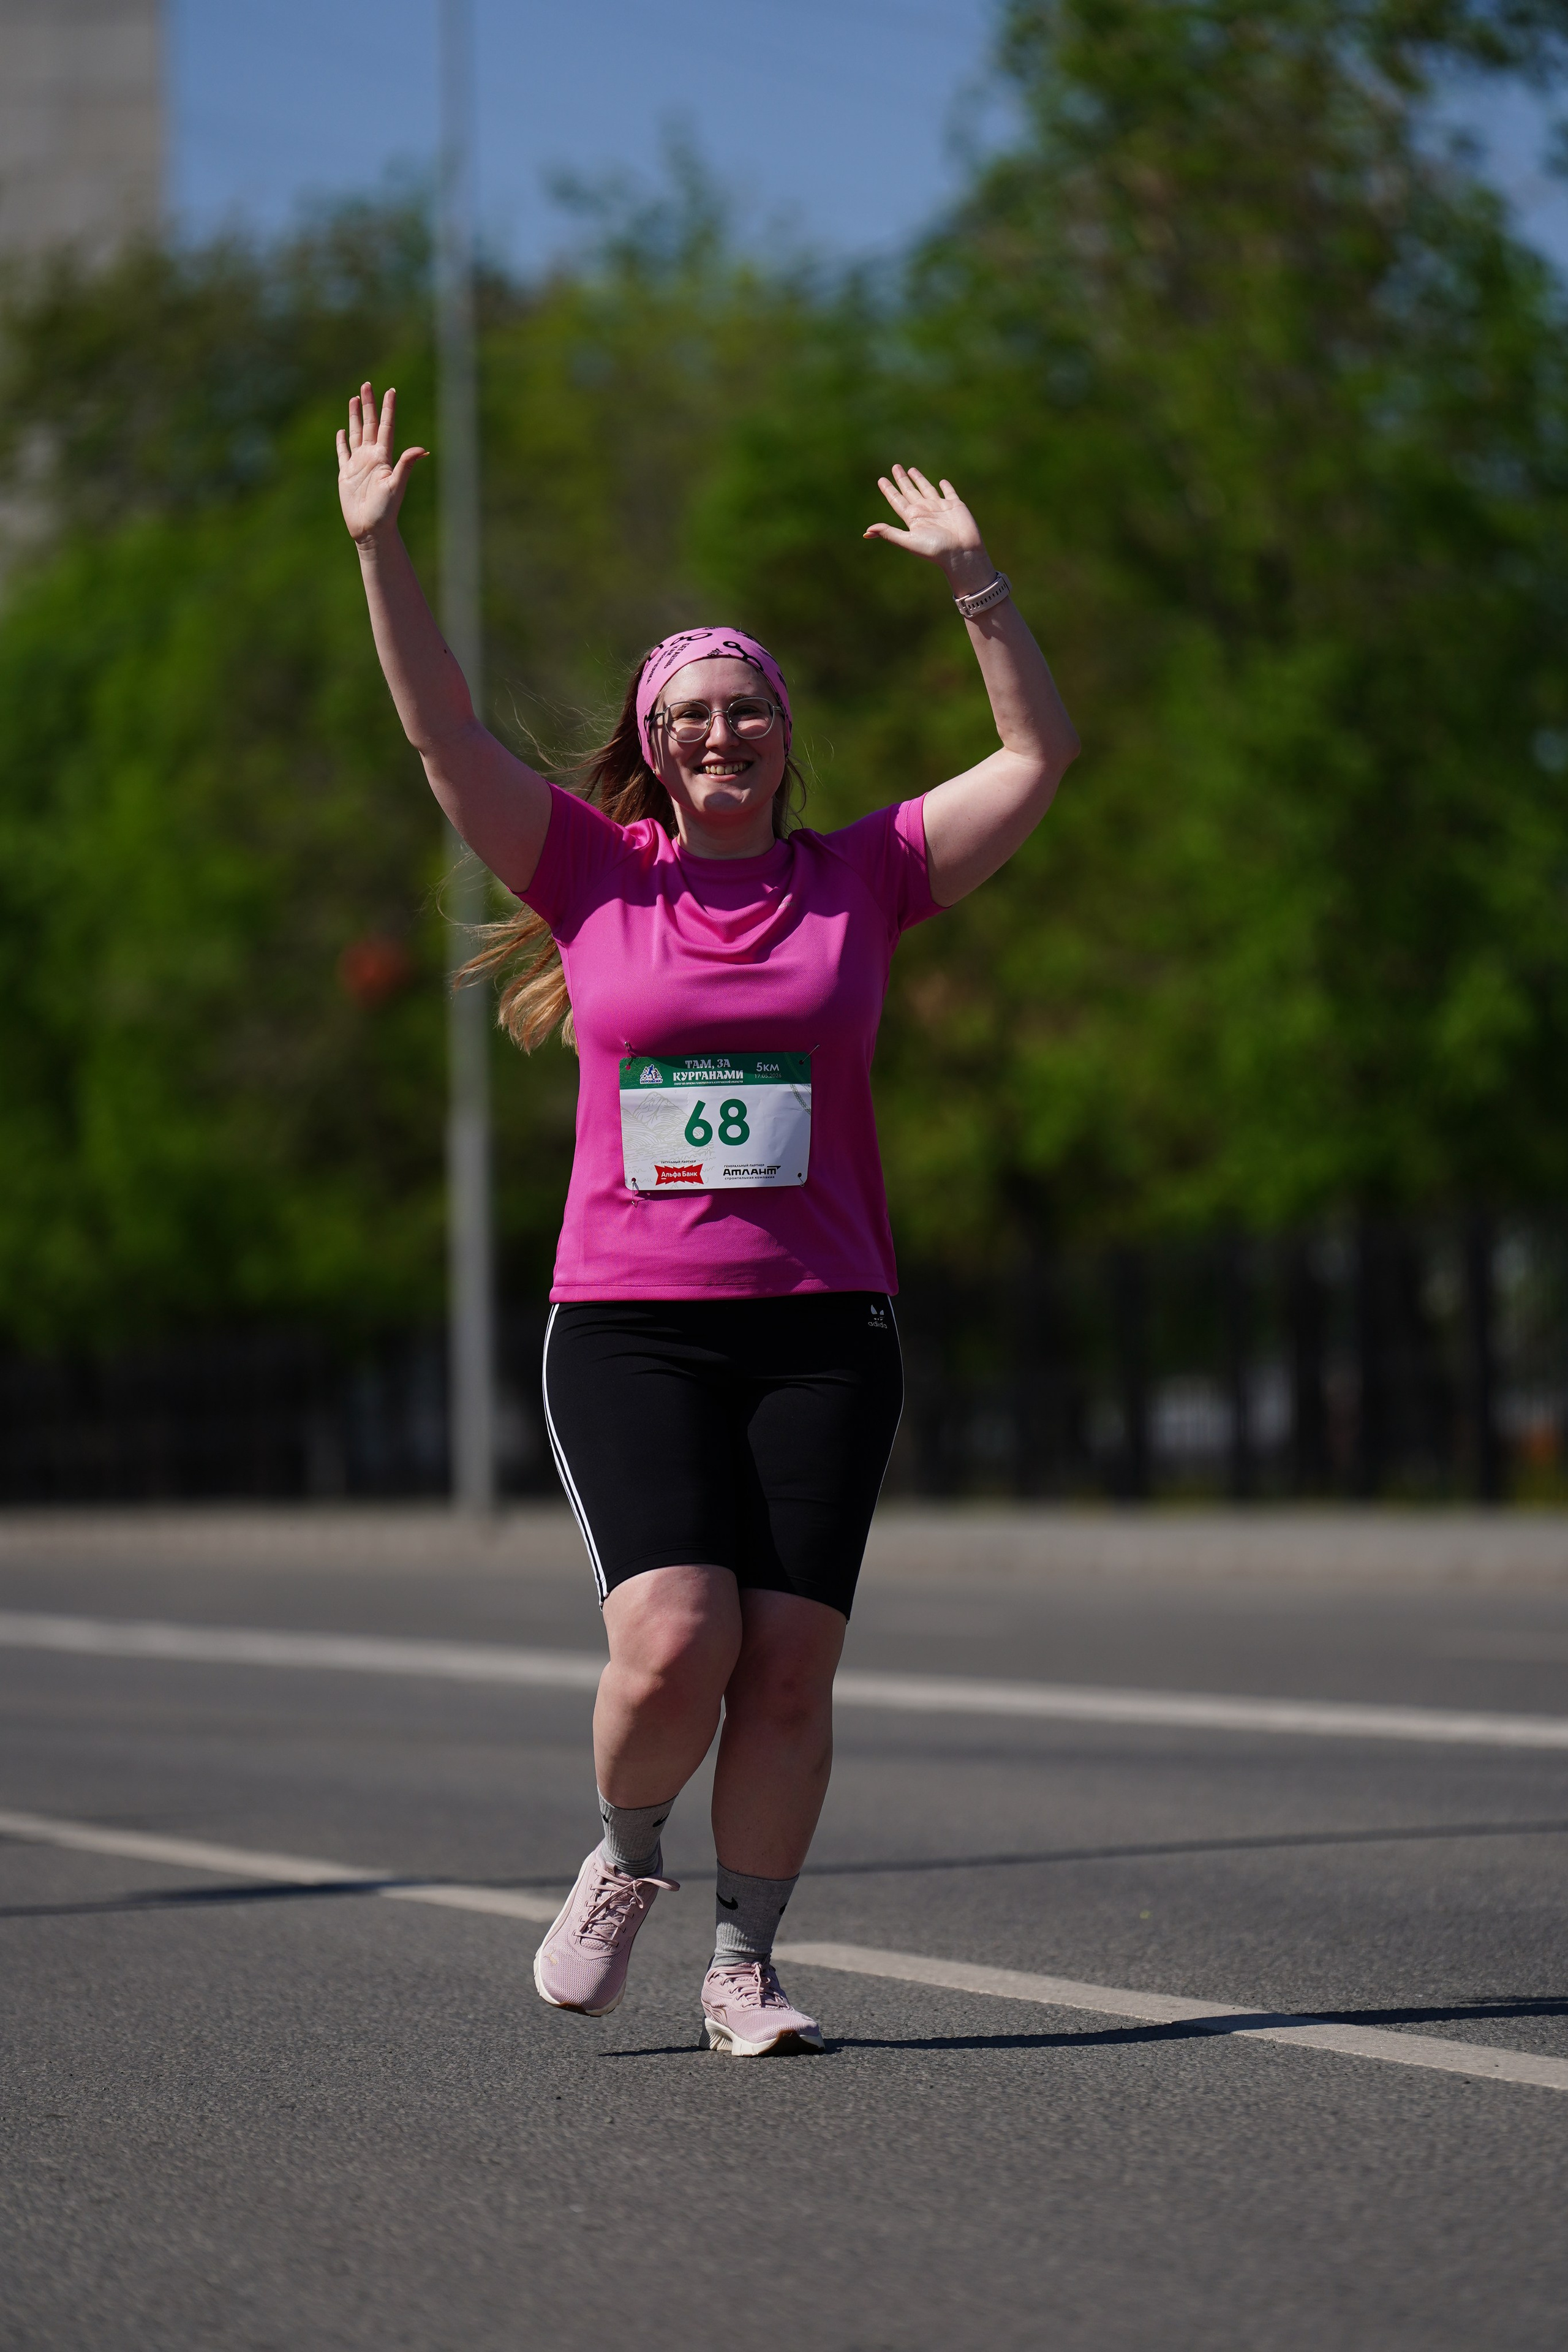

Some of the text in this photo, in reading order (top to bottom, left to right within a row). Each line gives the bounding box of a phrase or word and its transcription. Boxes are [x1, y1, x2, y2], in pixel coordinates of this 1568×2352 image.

[685, 1059, 731, 1069] ТАМ, ЗА
[673, 1070, 744, 1081] КУРГАНАМИ
[684, 1098, 750, 1147] 68
[661, 1170, 681, 1180] Альфа
